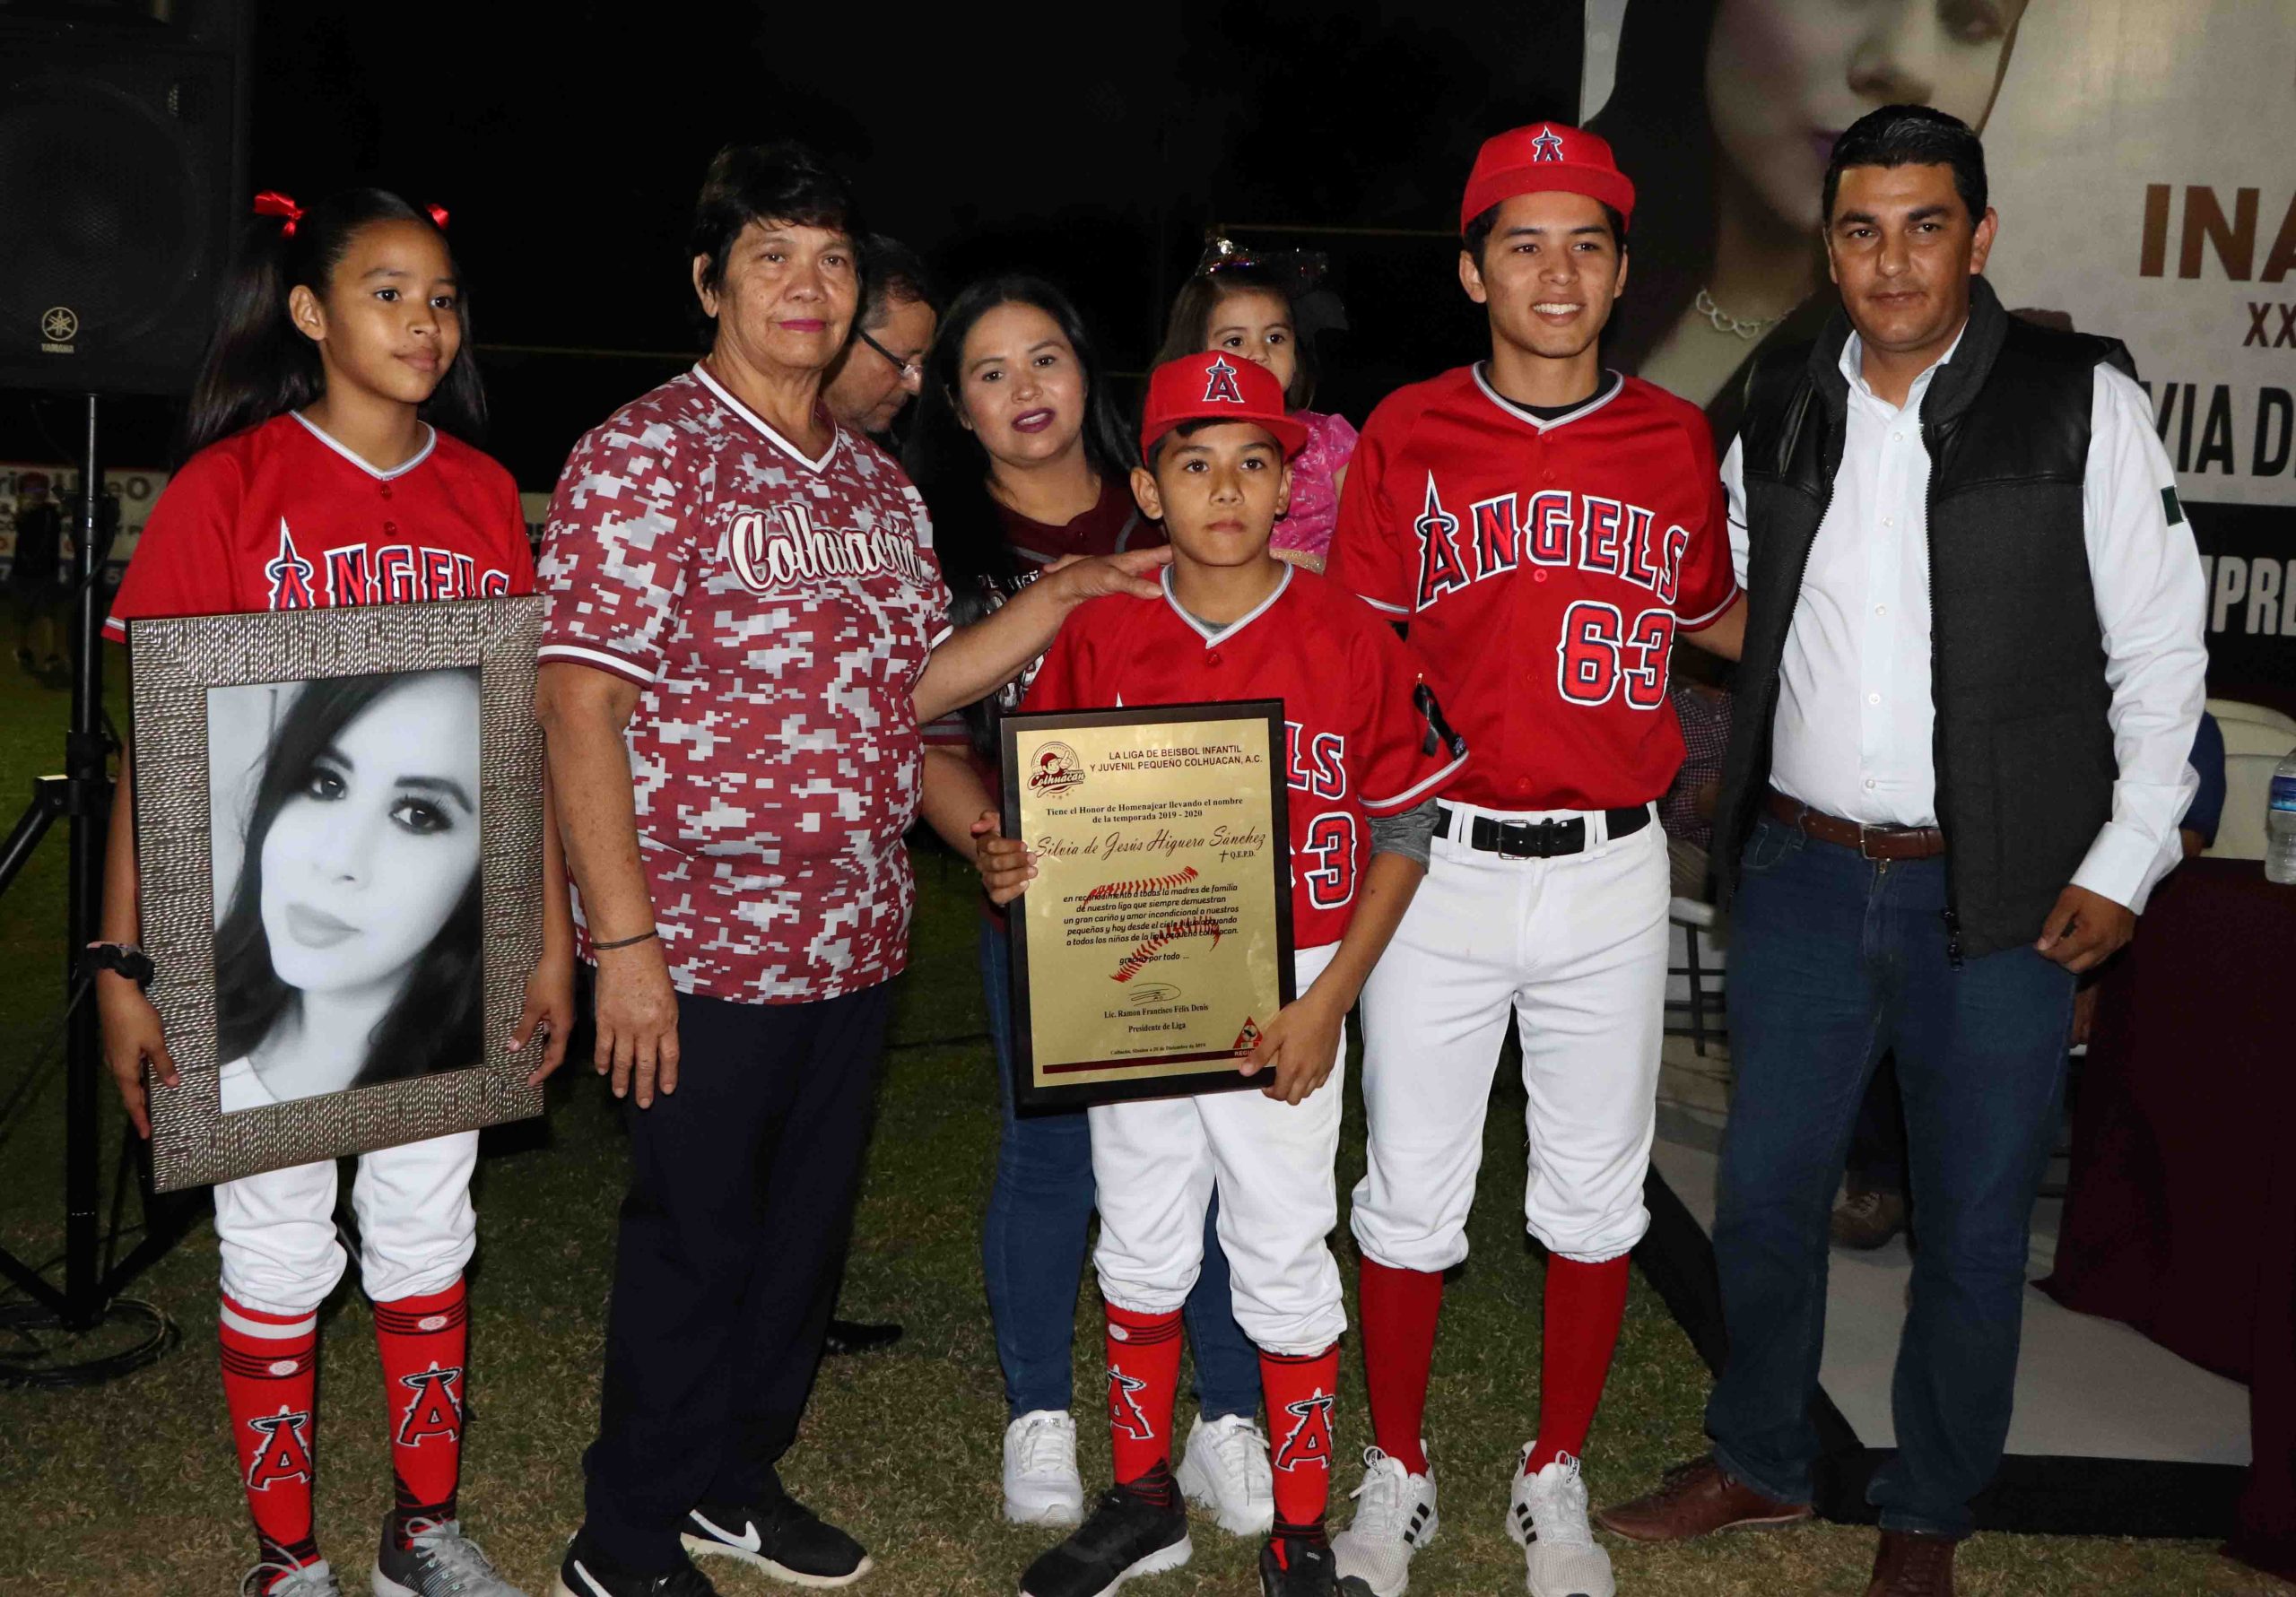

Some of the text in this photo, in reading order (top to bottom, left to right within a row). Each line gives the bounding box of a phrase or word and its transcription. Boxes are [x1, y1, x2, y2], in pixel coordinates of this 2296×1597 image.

[1414, 469, 1690, 612] ANGELS
[1557, 600, 1676, 709] 63
[1109, 744, 1241, 760] LA LIGA DE BEISBOL INFANTIL
[1090, 764, 1096, 772] Y
[1098, 761, 1135, 772] JUVENIL
[1137, 758, 1182, 770] PEQUEÑO
[1184, 756, 1243, 768] COLHUACAN,
[1245, 754, 1263, 763] A.C.
[1046, 808, 1068, 816] Tiene
[1070, 807, 1077, 815] el
[1079, 806, 1105, 814] Honor
[1107, 804, 1117, 812] de
[1118, 802, 1167, 812] Homenajear
[1169, 799, 1203, 809] llevando
[1213, 797, 1243, 806] nombre
[1091, 816, 1102, 824] de
[1103, 815, 1111, 823] la
[1113, 812, 1156, 823] temporada
[1158, 811, 1177, 820] 2019
[1184, 810, 1203, 818] 2020
[1035, 825, 1266, 861] Silvia de Jesús Higuera Sánchez
[1290, 811, 1357, 910] 3
[1170, 886, 1200, 895] madres
[1200, 884, 1210, 893] de
[1211, 882, 1238, 894] familia
[1075, 896, 1227, 913] de nuestra liga que siempre demuestran
[1074, 916, 1093, 925] gran
[1094, 914, 1119, 923] cariño
[1119, 915, 1126, 923] y
[1148, 907, 1199, 919] incondicional
[1206, 906, 1239, 915] nuestros
[1066, 925, 1104, 937] pequeños
[1105, 926, 1110, 934] y
[1111, 924, 1126, 933] hoy
[1126, 922, 1150, 931] desde
[1151, 921, 1159, 929] el
[1073, 936, 1094, 945] todos
[1095, 935, 1107, 944] los
[1108, 933, 1129, 942] niños
[1130, 933, 1140, 942] de
[1141, 933, 1149, 941] la
[1148, 954, 1162, 963] por
[1163, 951, 1180, 960] todo
[1104, 1011, 1117, 1019] Lic.
[1142, 1006, 1173, 1016] Francisco
[1128, 1020, 1186, 1033] Presidente de Liga
